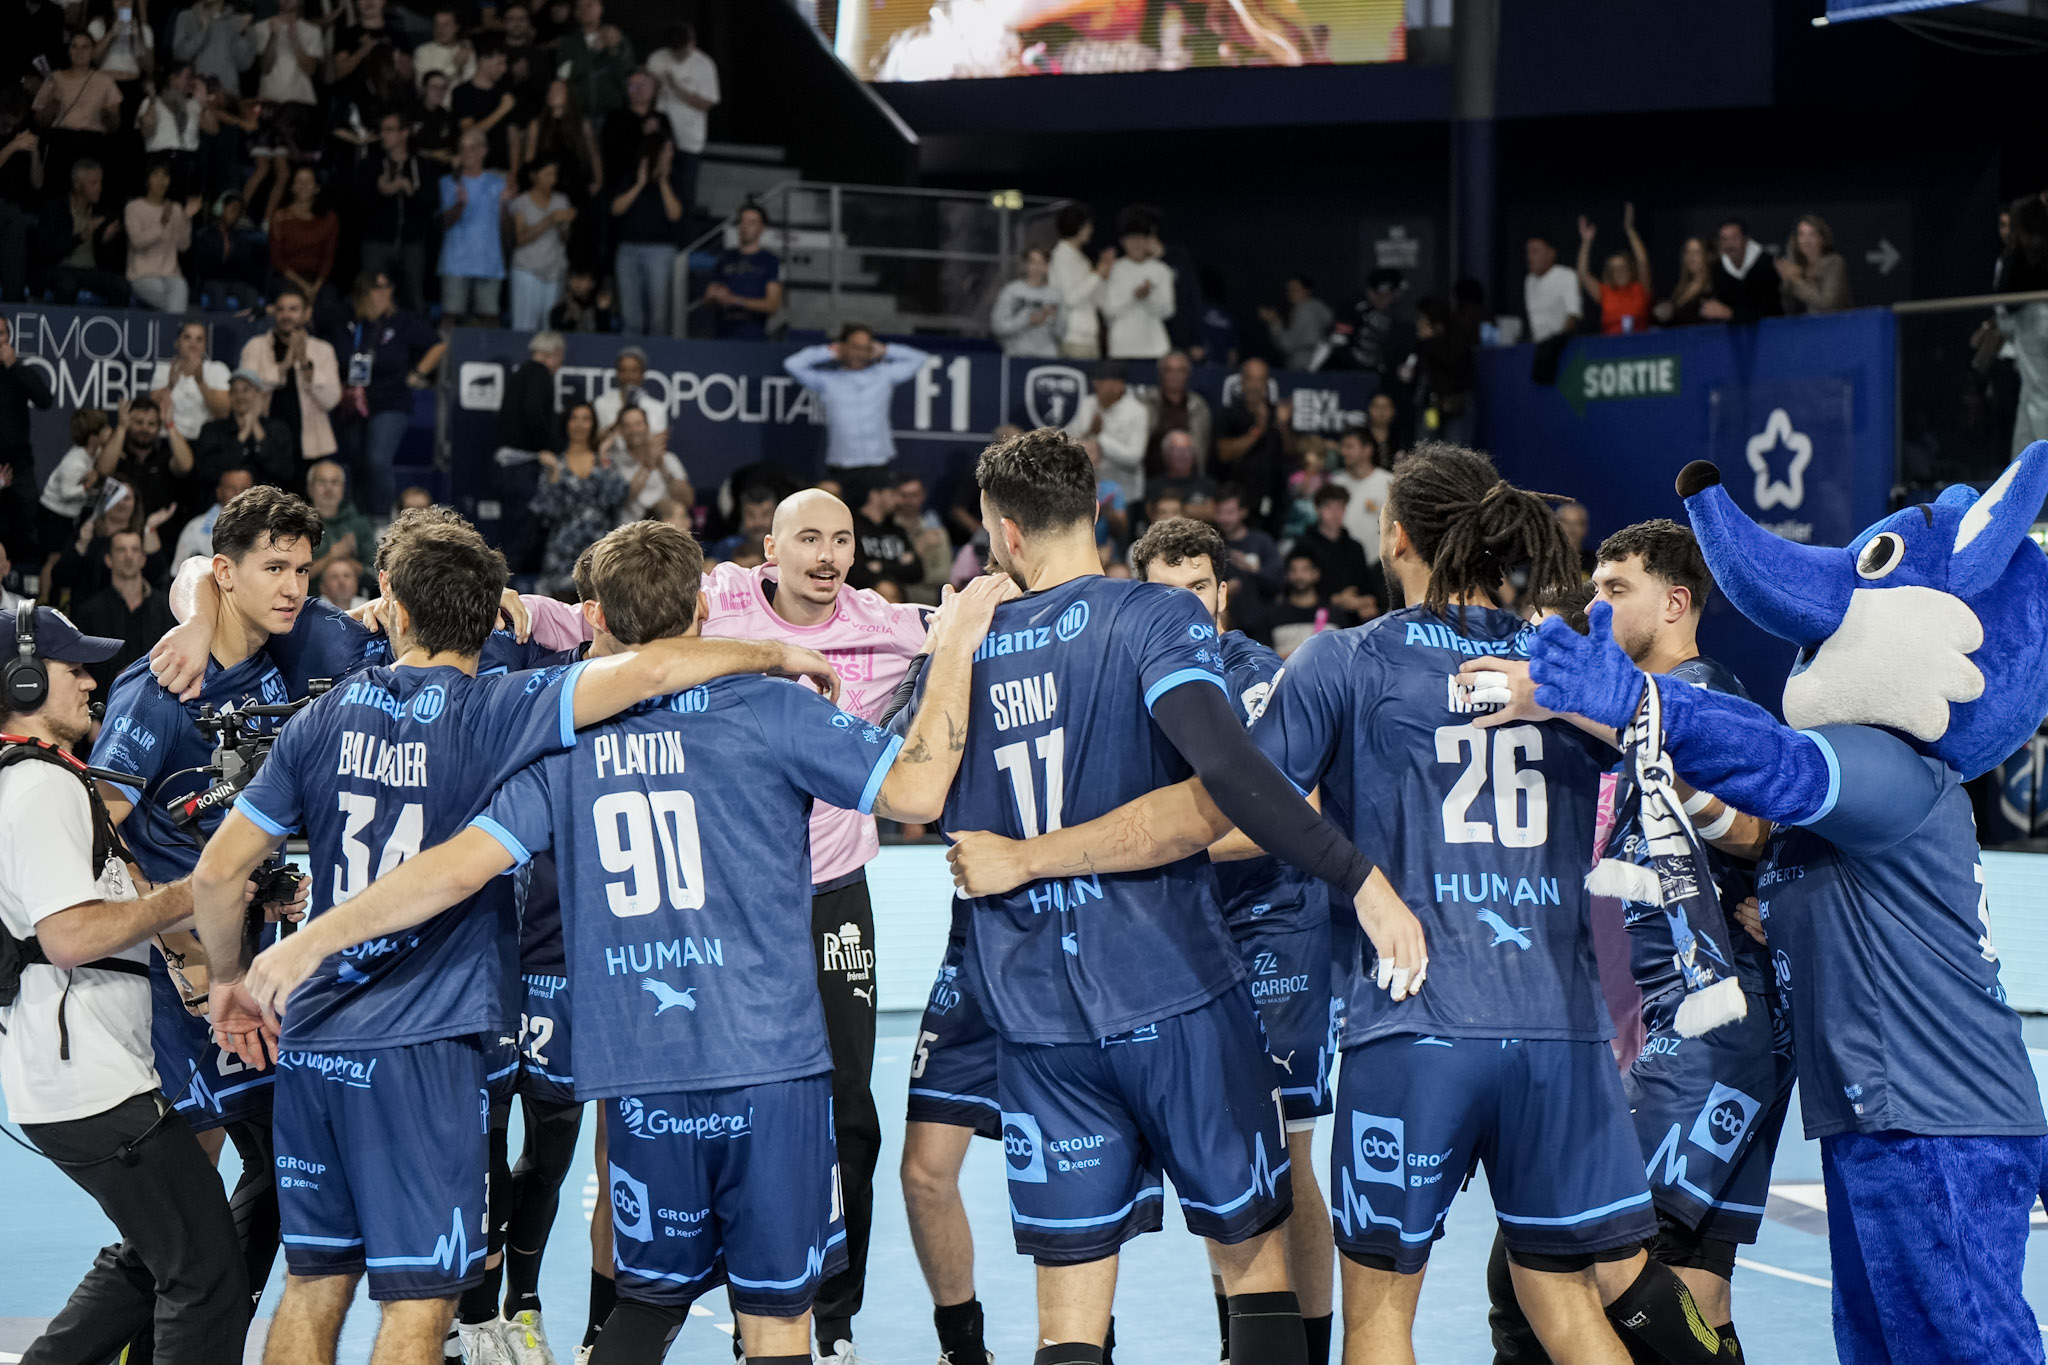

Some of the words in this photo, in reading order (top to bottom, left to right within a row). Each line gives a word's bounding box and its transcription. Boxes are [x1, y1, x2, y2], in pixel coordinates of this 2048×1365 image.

[1583, 358, 1674, 398] SORTIE
[913, 354, 971, 432] F1
[852, 621, 893, 635] VEOLIA
[1405, 622, 1511, 656] Allianz
[990, 672, 1058, 731] SRNA
[114, 716, 133, 732] ON
[130, 726, 156, 751] AIR
[196, 781, 236, 809] RONIN
[1434, 724, 1548, 848] 26
[332, 791, 425, 906] 34
[592, 790, 705, 918] 90
[1434, 873, 1561, 905] HUMAN
[605, 937, 724, 975] HUMAN
[823, 932, 874, 979] Philip
[1251, 975, 1309, 997] CARROZ
[1711, 1107, 1743, 1136] cbc
[1004, 1132, 1033, 1157] cbc
[1050, 1134, 1104, 1153] GROUP
[1362, 1136, 1400, 1160] cbc
[276, 1156, 326, 1175] GROUP
[1072, 1157, 1101, 1170] xerox
[1423, 1171, 1443, 1185] xero
[293, 1178, 319, 1189] xerox
[614, 1188, 640, 1219] cbc
[657, 1207, 710, 1223] GROUP
[676, 1227, 703, 1238] xerox
